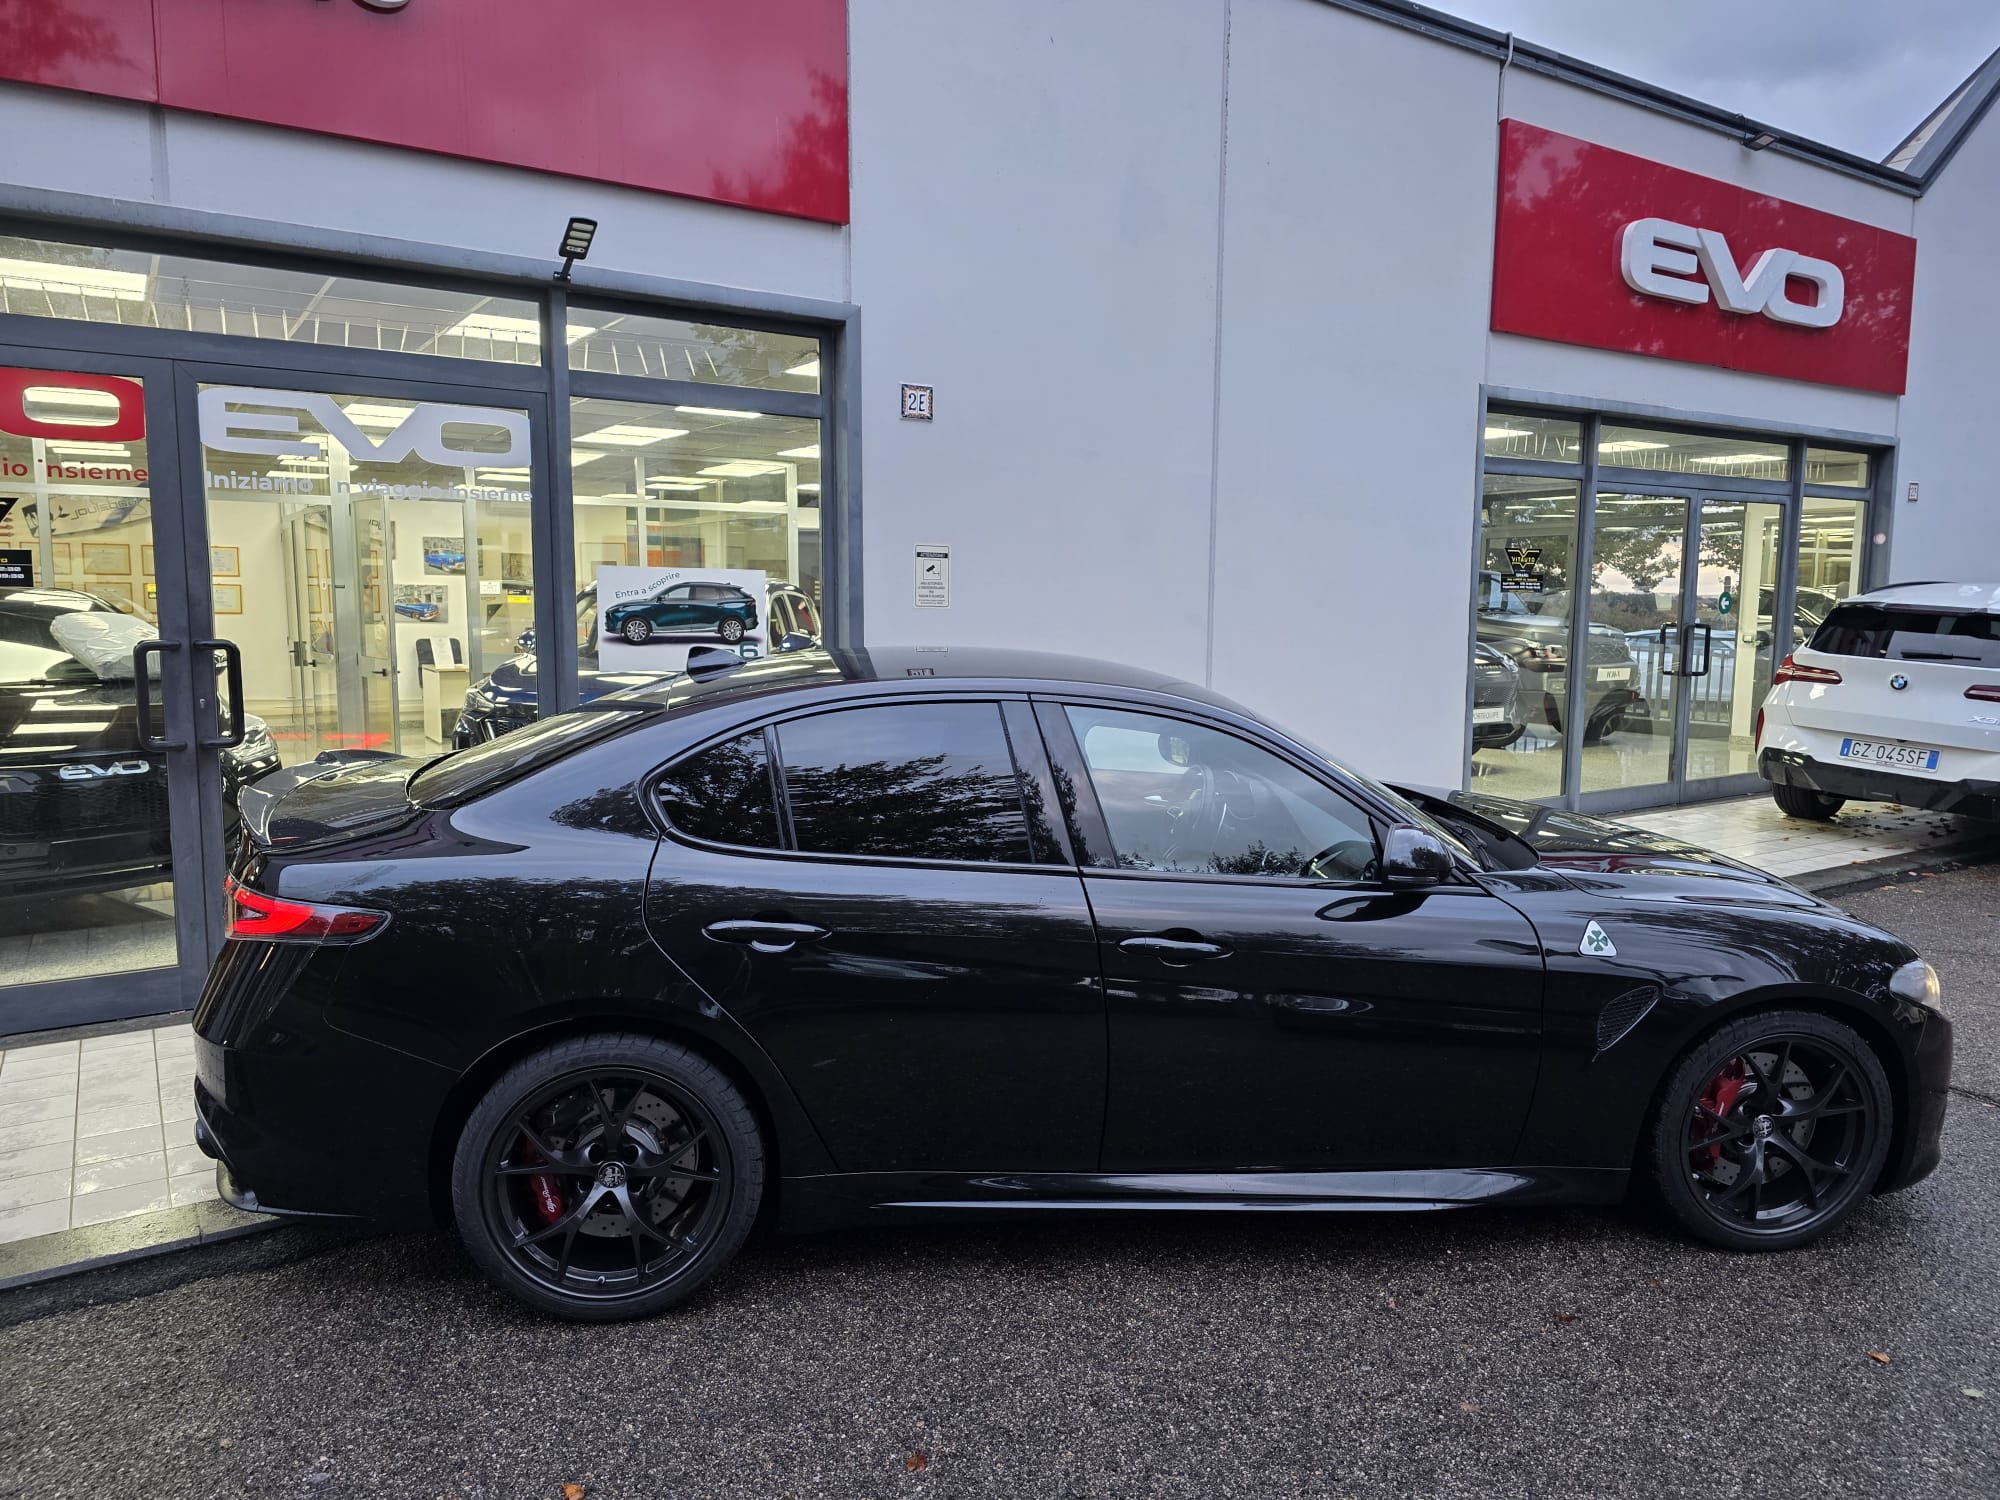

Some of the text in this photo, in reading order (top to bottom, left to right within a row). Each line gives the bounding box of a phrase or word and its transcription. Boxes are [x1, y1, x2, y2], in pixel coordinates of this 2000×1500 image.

[1621, 217, 1845, 328] EVO
[908, 392, 926, 412] 2E
[199, 386, 532, 468] EVO
[37, 457, 148, 481] nsieme
[206, 470, 313, 493] Iniziamo
[358, 477, 444, 501] viaggio
[449, 481, 532, 502] insieme
[615, 589, 639, 599] Entra
[649, 571, 681, 592] scoprire
[1851, 742, 1871, 758] GZ
[1876, 745, 1928, 766] 045SF
[59, 760, 150, 780] EVO
